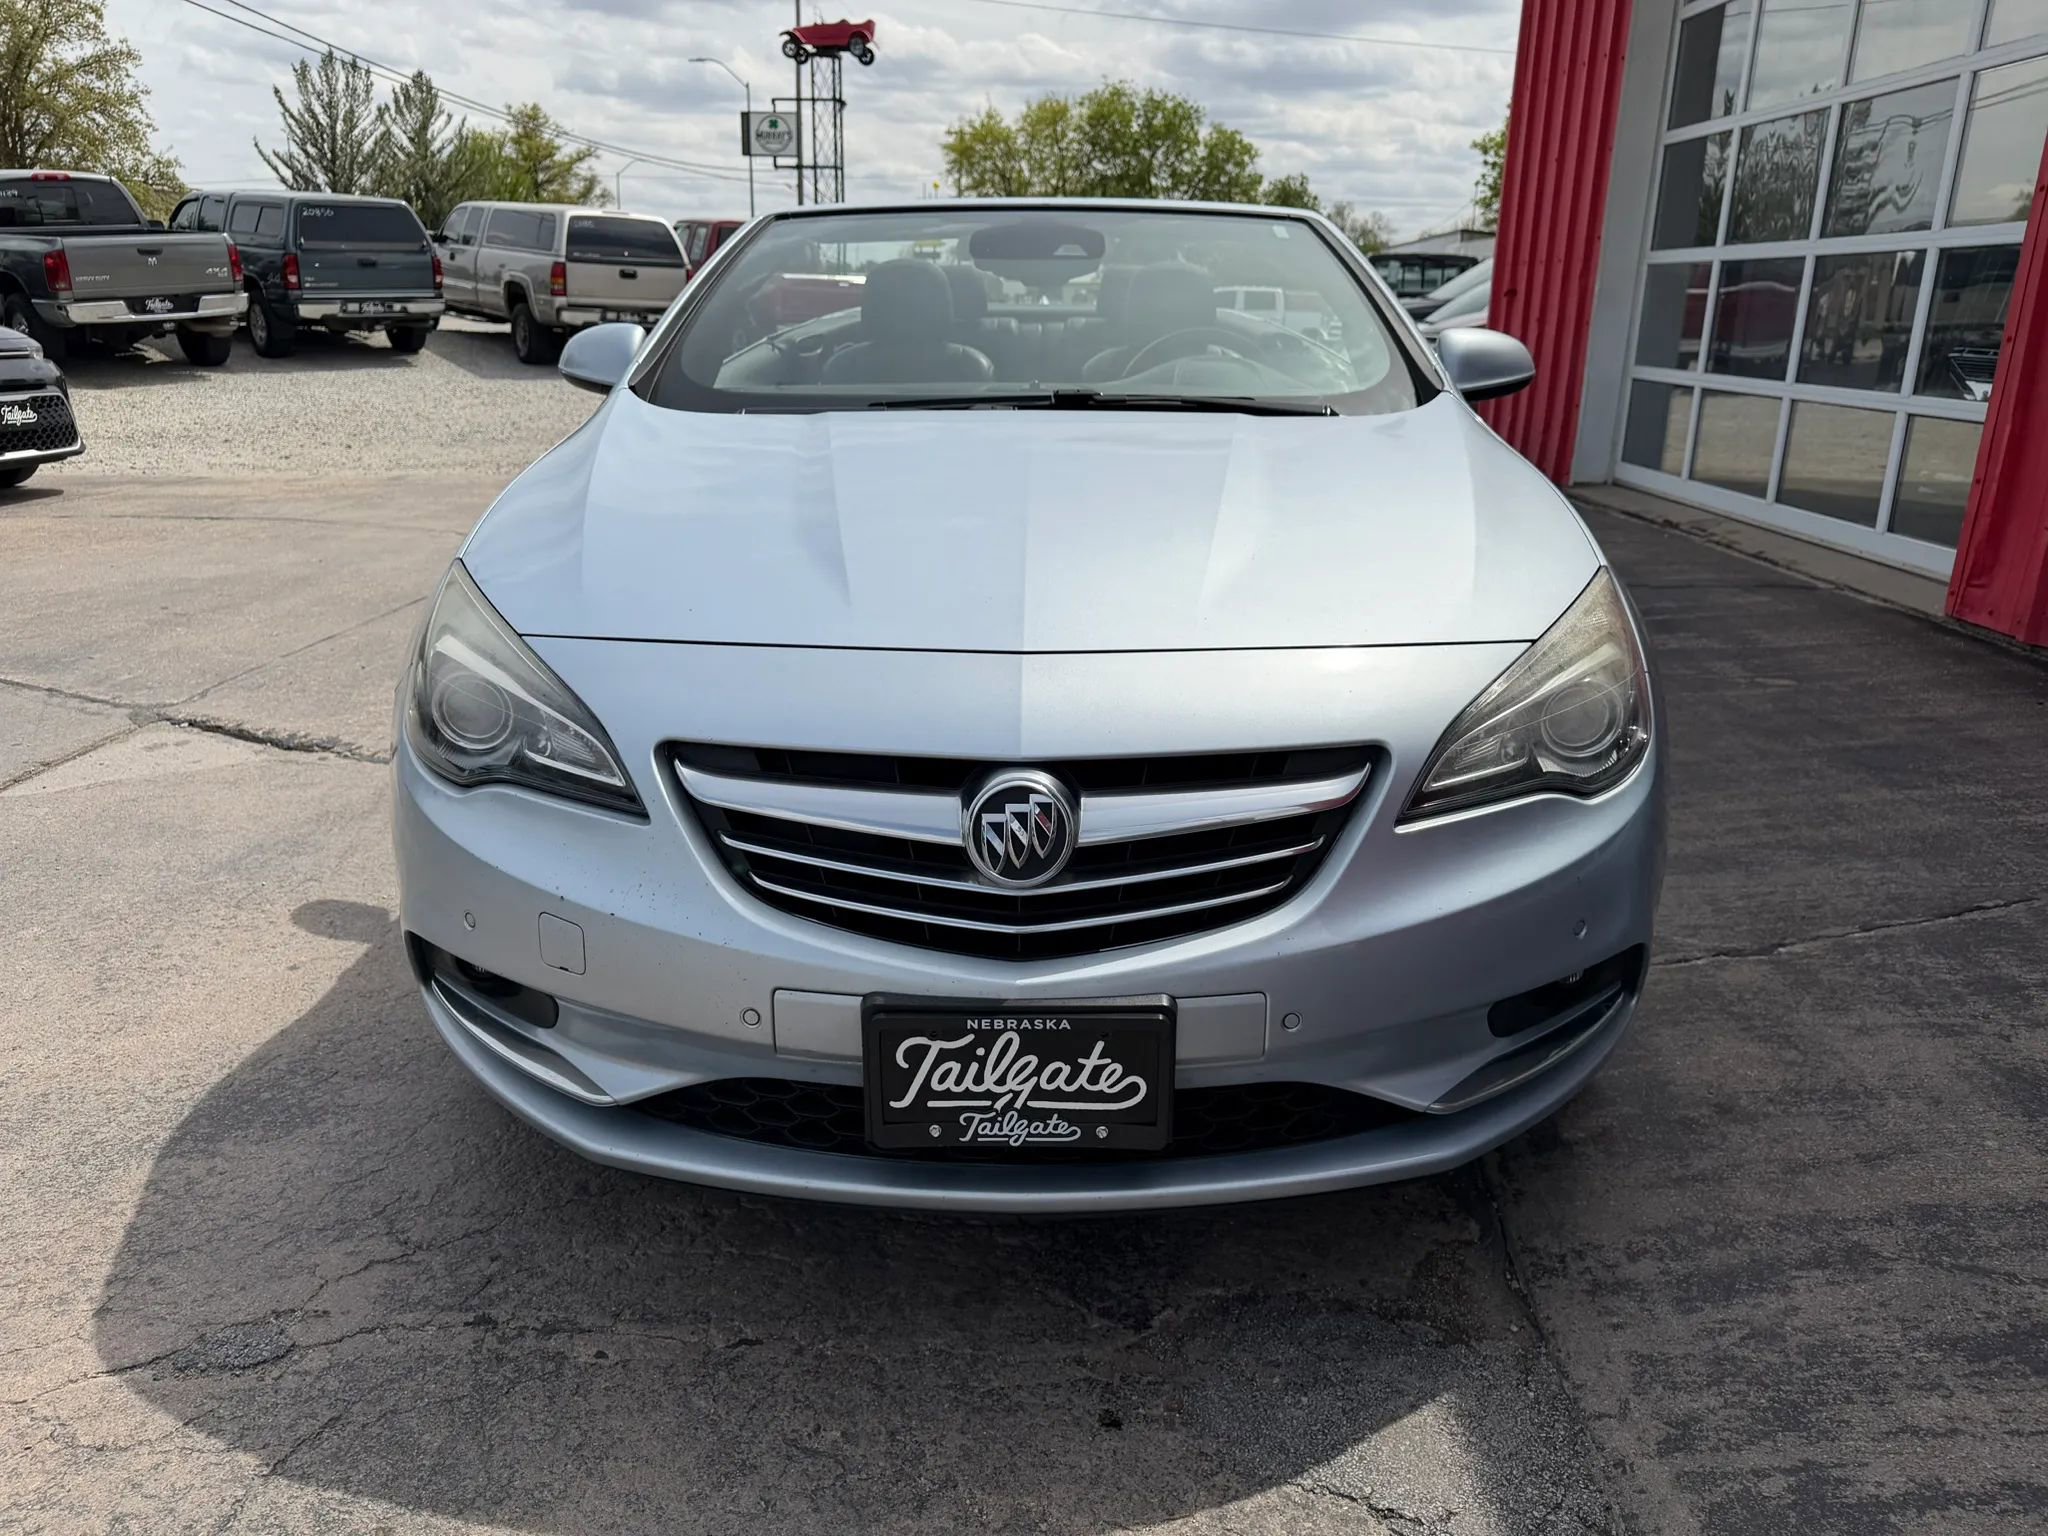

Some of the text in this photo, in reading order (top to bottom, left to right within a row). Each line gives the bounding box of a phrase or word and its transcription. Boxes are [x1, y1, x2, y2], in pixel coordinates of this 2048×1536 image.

[1, 403, 38, 426] Tailgate
[966, 1019, 1071, 1030] NEBRASKA
[889, 1031, 1147, 1112] Tailgate
[959, 1110, 1081, 1146] Tailgate
